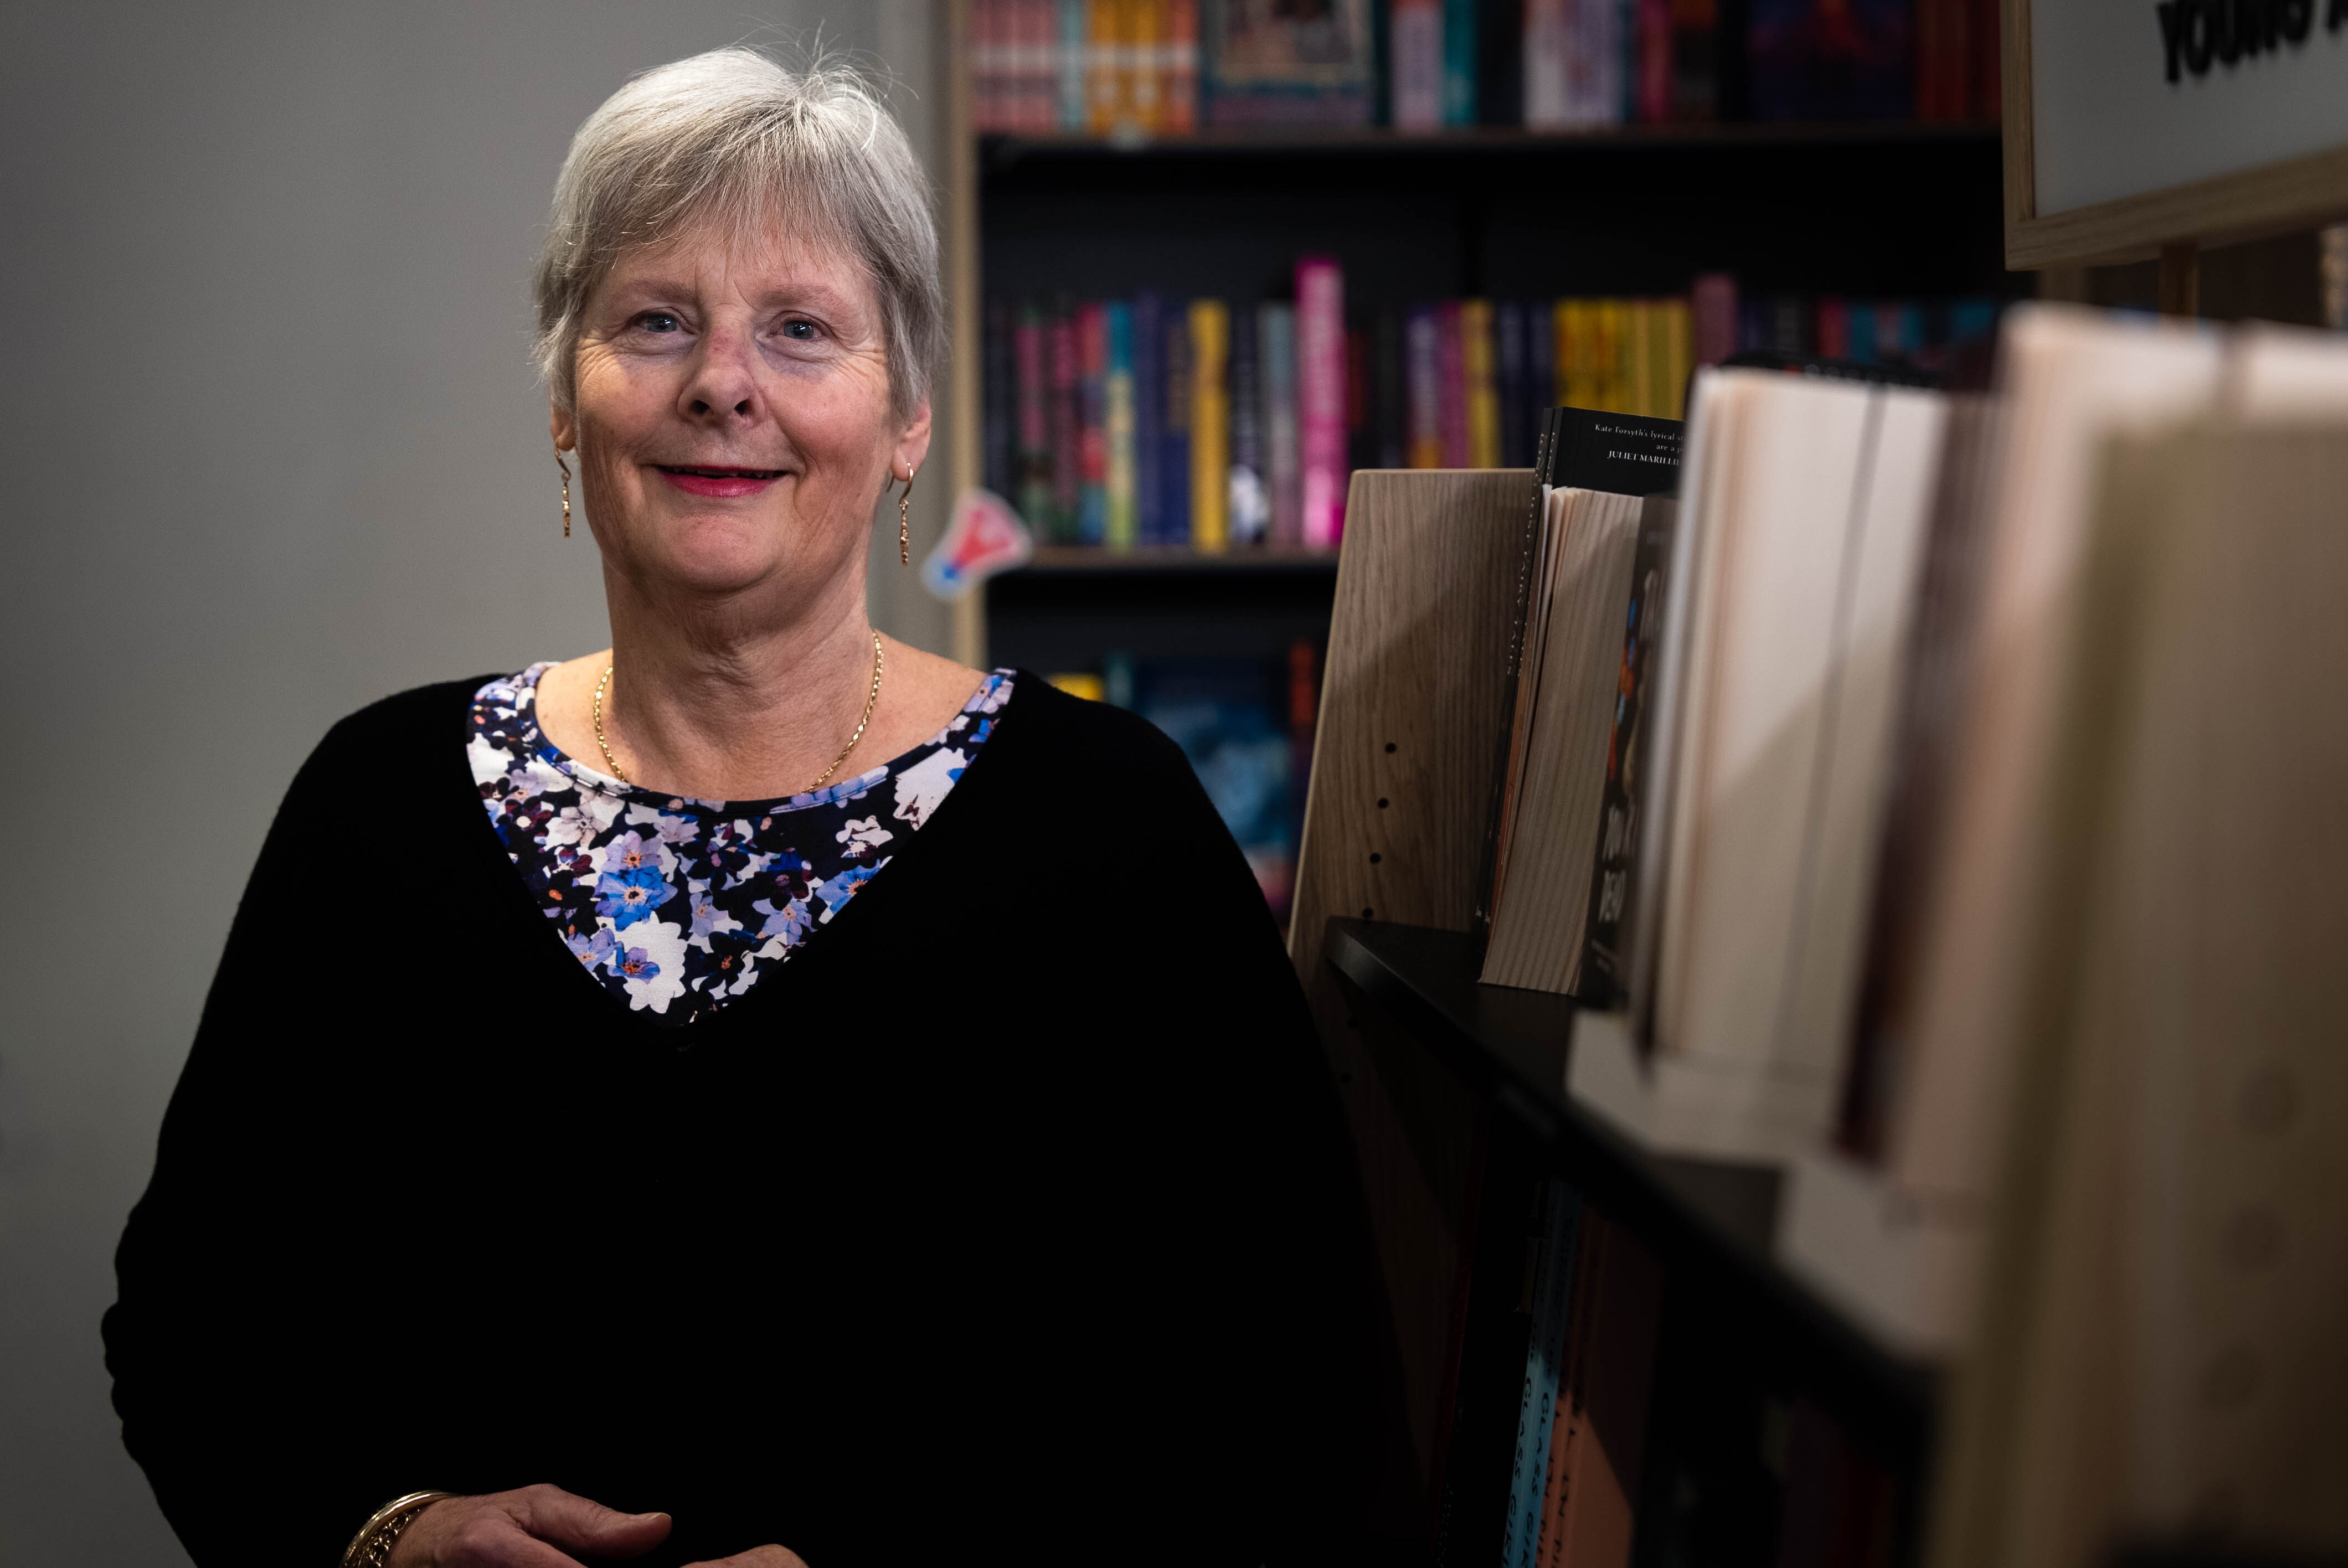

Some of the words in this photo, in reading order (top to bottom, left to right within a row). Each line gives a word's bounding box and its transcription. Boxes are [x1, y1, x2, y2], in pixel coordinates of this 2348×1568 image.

[2157, 0, 2312, 82] YOUNG
[1595, 424, 1612, 432] Kate
[1615, 426, 1649, 438] Forsyth's
[1651, 430, 1675, 441] lyrical
[1607, 450, 1639, 461] JULIET
[1640, 454, 1680, 466] MARILLI
[1515, 1376, 1532, 1480] GLASS
[1531, 1392, 1549, 1497] GLASS
